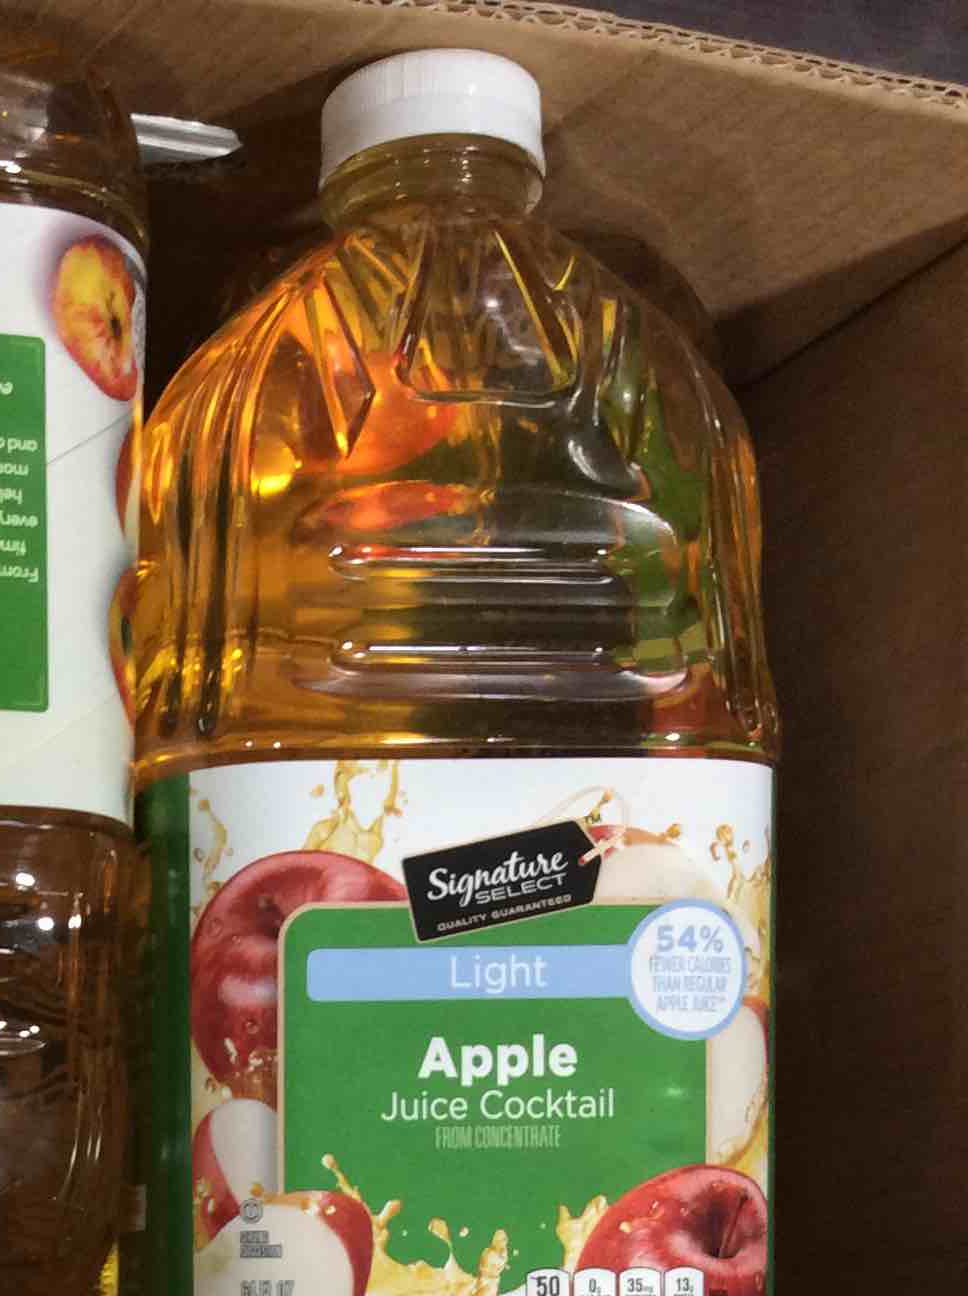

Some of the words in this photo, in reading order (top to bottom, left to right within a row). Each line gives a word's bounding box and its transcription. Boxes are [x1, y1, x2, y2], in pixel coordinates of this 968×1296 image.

[8, 437, 38, 453] and
[427, 850, 569, 908] Signature
[474, 871, 568, 904] SELECT
[437, 912, 487, 932] QUALITY
[490, 893, 572, 920] GUARANTEED
[655, 925, 723, 954] 54%
[450, 955, 549, 994] Light
[418, 1034, 578, 1087] Apple
[381, 1091, 468, 1121] Juice
[479, 1087, 615, 1120] Cocktail
[435, 1125, 473, 1148] FROM
[475, 1124, 561, 1148] CONCENTRATE
[536, 1275, 560, 1296] 50
